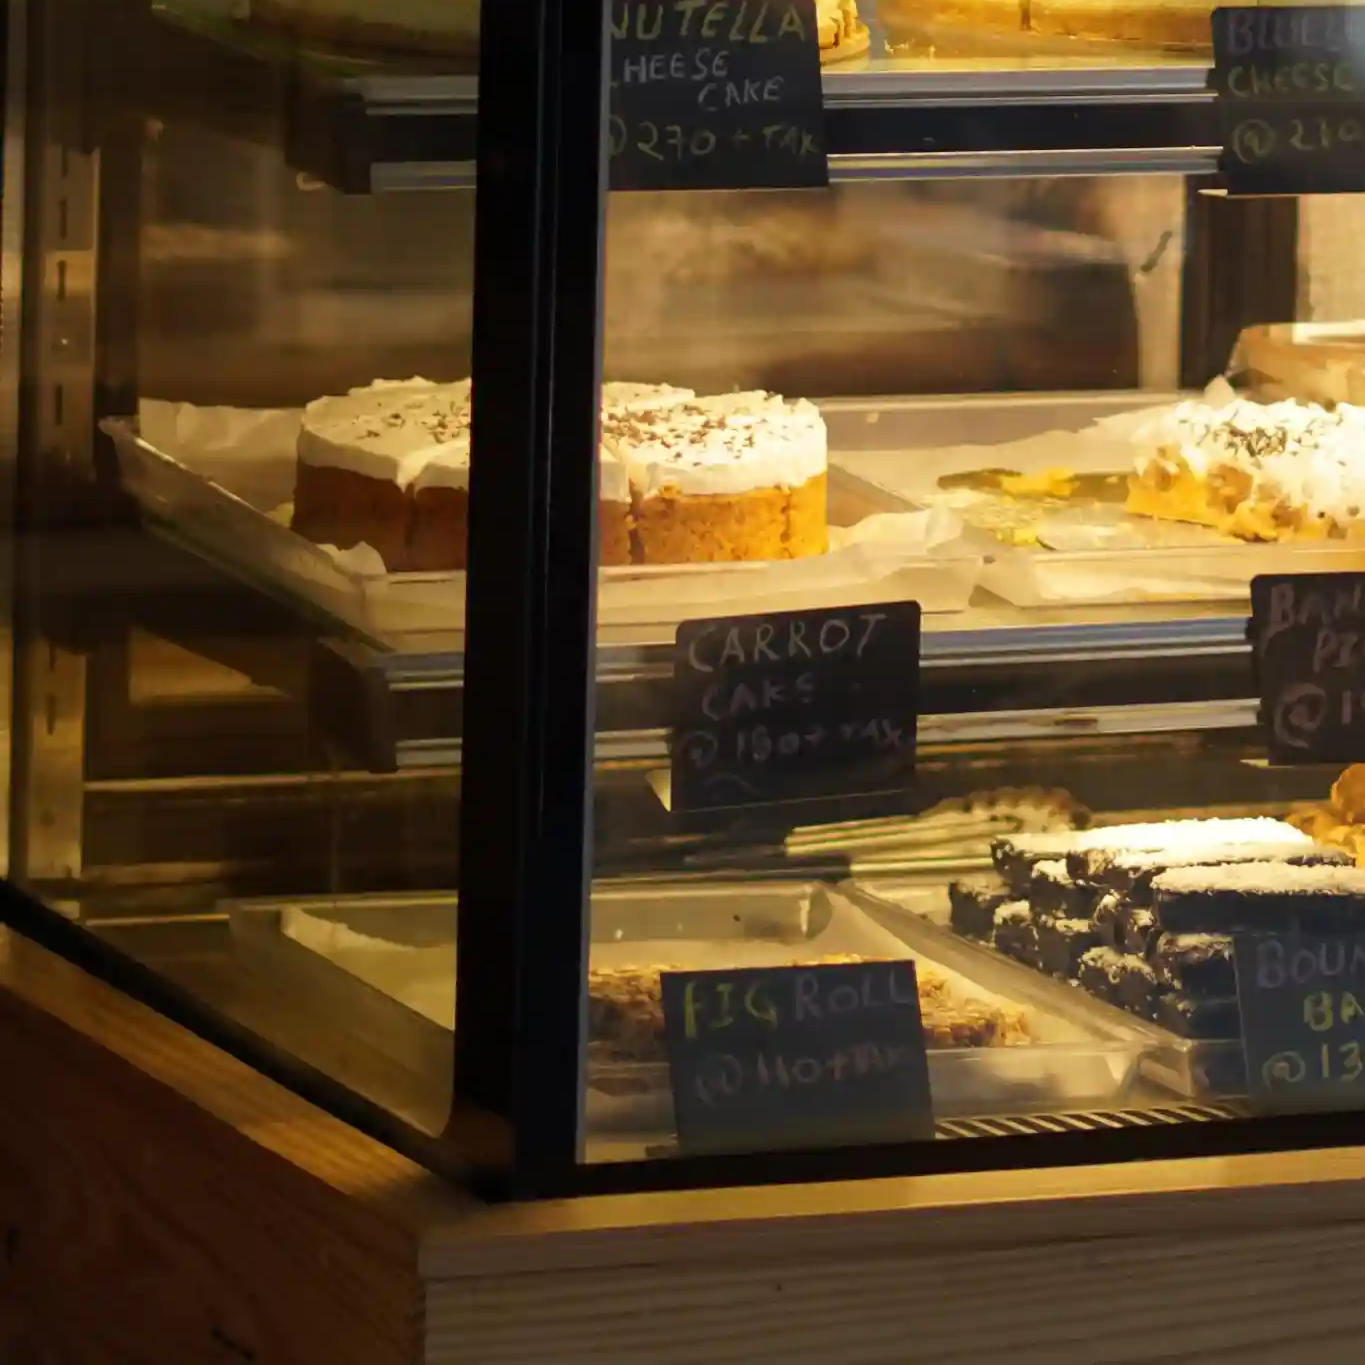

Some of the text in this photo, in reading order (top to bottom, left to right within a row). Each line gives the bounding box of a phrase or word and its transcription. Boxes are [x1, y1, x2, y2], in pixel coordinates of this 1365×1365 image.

[611, 47, 731, 88] HEESE
[698, 75, 785, 111] CAKE
[688, 613, 888, 673] CARROT
[701, 672, 815, 722] CAKE
[683, 968, 914, 1039] FIG ROLL
